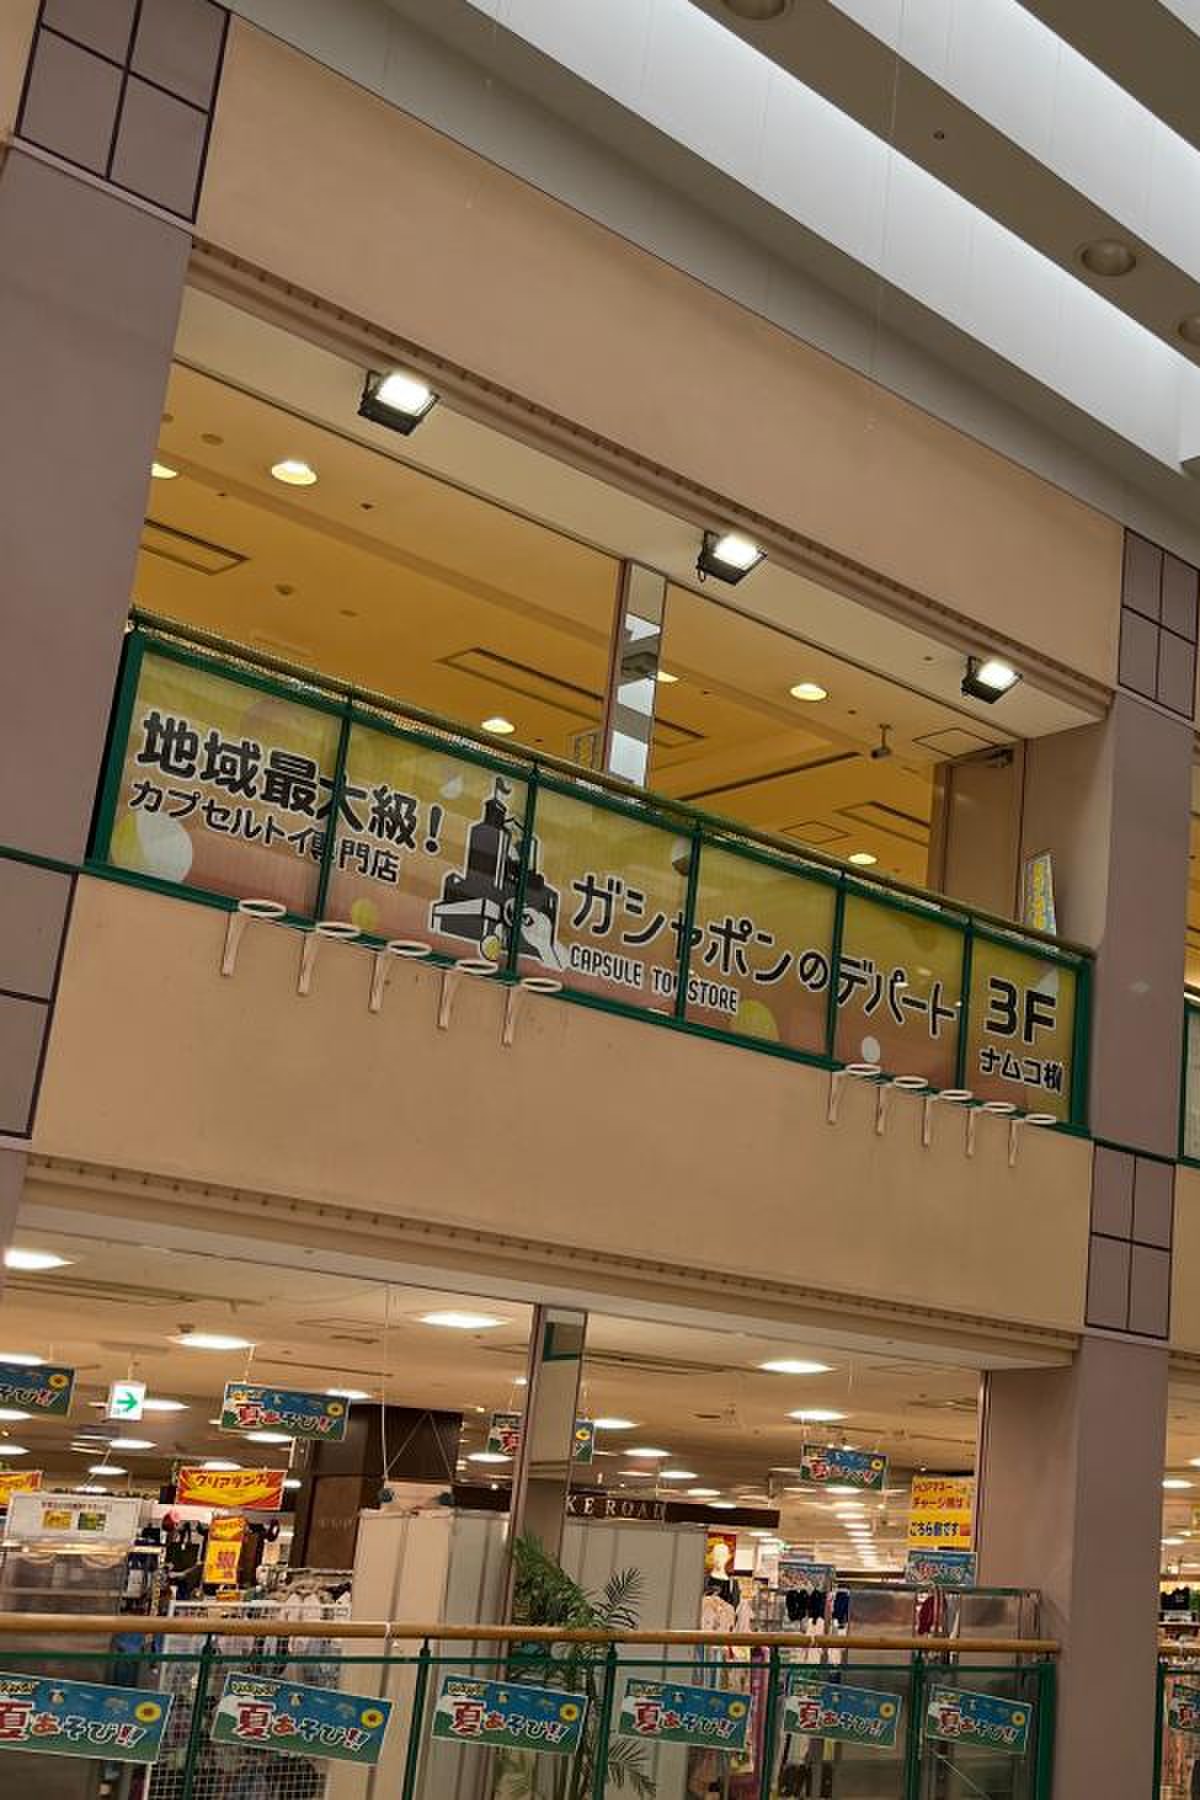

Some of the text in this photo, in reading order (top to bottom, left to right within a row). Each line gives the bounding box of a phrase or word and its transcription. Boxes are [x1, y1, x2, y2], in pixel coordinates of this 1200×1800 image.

[570, 945, 643, 986] CAPSULE
[687, 979, 737, 1013] STORE
[572, 875, 956, 1036] ガシャポンのデパート
[985, 976, 1057, 1042] 3F
